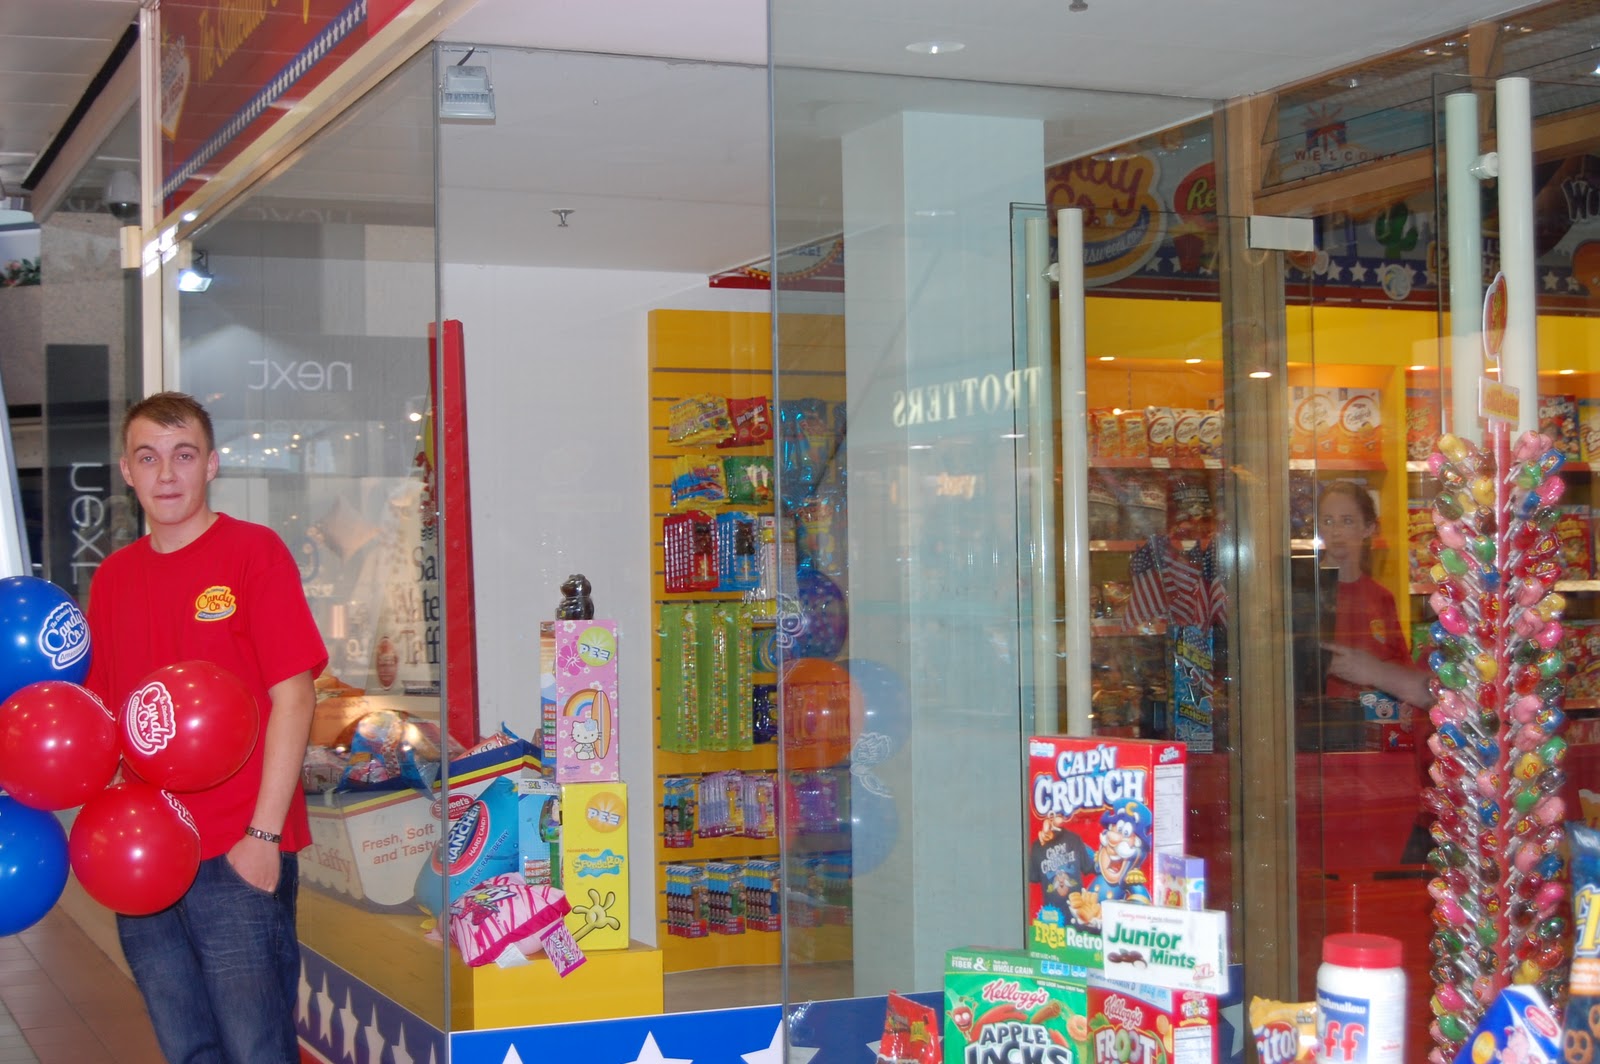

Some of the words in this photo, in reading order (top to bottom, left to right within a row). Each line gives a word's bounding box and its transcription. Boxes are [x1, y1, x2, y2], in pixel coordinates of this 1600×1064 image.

[198, 589, 233, 609] Candy
[45, 606, 85, 652] Candy
[579, 643, 611, 661] PEZ
[141, 686, 169, 742] Candy
[1034, 768, 1146, 816] CRUNCH
[587, 807, 621, 826] PEZ
[406, 823, 435, 841] Soft
[373, 849, 398, 865] and
[468, 836, 482, 857] HARD
[469, 866, 485, 887] BLUE
[481, 830, 511, 869] RASBERRY
[1033, 918, 1066, 949] FREE
[1066, 926, 1103, 951] Retro
[1107, 922, 1183, 950] Junior
[951, 960, 972, 969] FIBER
[992, 963, 1014, 974] WHOLE
[1014, 966, 1034, 976] GRAIN
[1149, 949, 1197, 970] Mints
[983, 978, 1050, 1010] Kellogg's
[1104, 993, 1144, 1031] Kellogg's
[980, 1021, 1048, 1046] APPLE
[1096, 1028, 1156, 1064] FROOT
